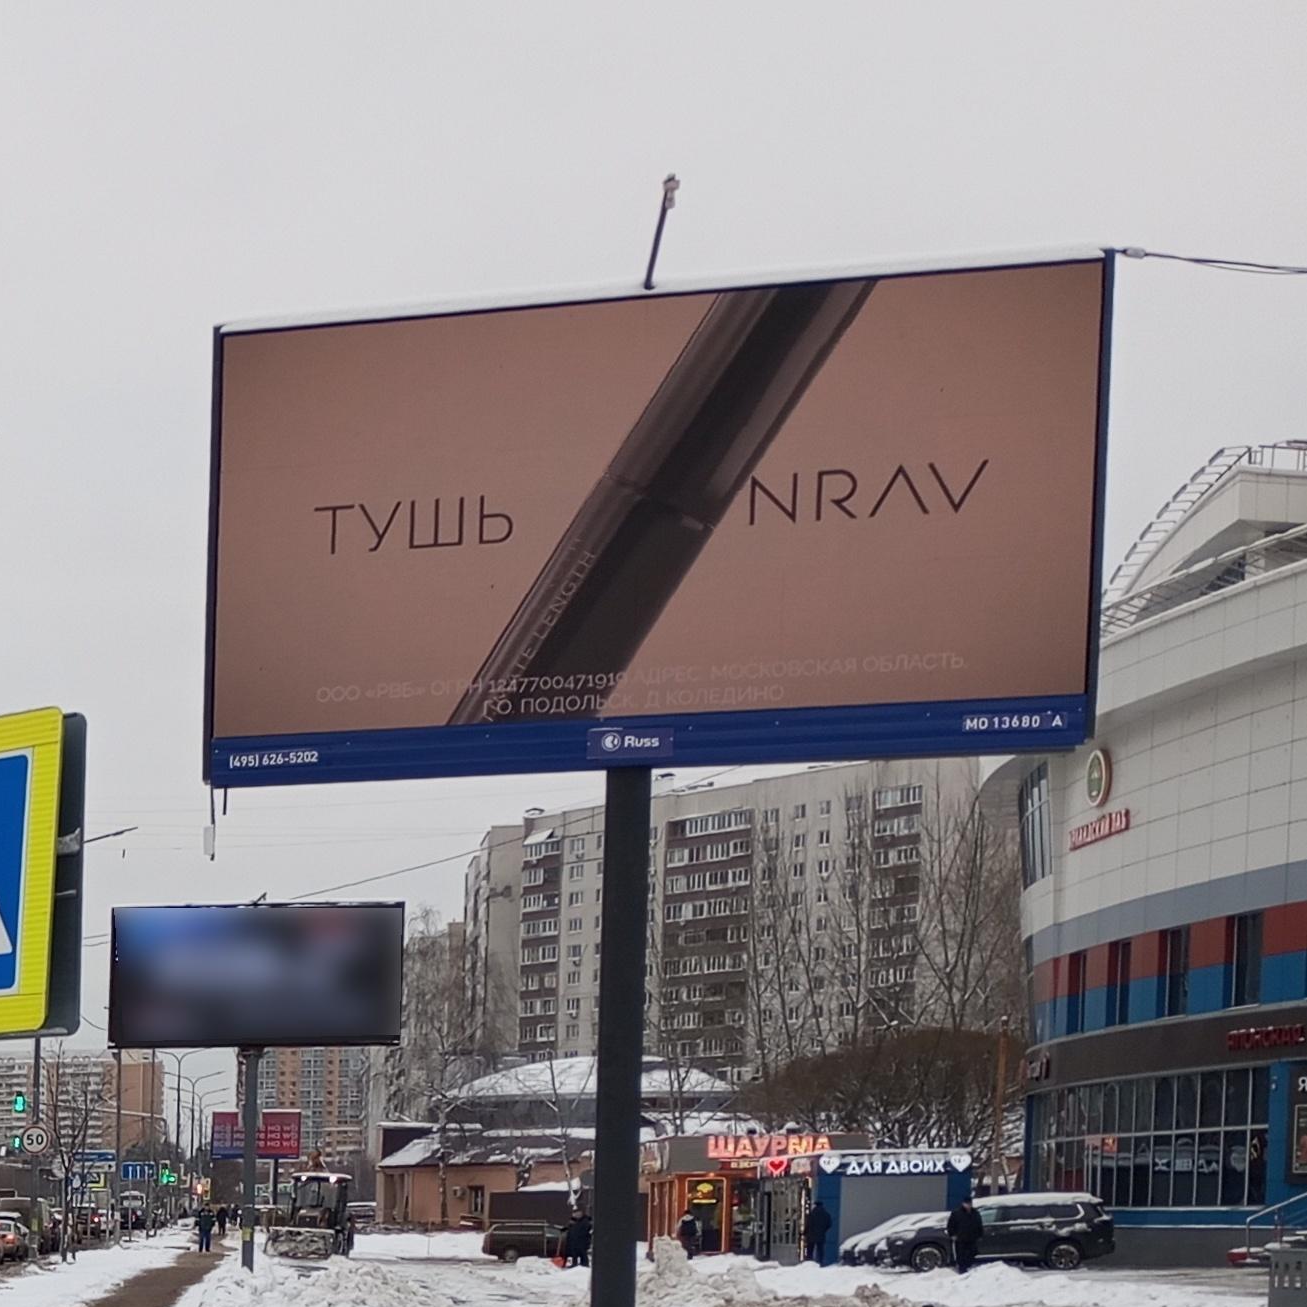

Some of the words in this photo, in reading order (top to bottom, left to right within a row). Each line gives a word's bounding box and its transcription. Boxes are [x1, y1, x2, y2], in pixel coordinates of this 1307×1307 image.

[749, 459, 989, 526] NRAV
[314, 494, 514, 556] ТУШЬ
[315, 686, 362, 704] ООО
[430, 679, 483, 697] ОГРН
[710, 655, 858, 682] МОСКОВСКАЯ
[666, 684, 785, 706] КОЛЕДИНО
[992, 715, 1041, 729] 13680
[623, 735, 660, 748] Russ
[228, 754, 259, 769] (495)
[261, 751, 319, 766] 626-5202
[26, 1133, 44, 1146] 50
[846, 1159, 883, 1175] ДЛЯ
[886, 1158, 946, 1175] ДВОИХ
